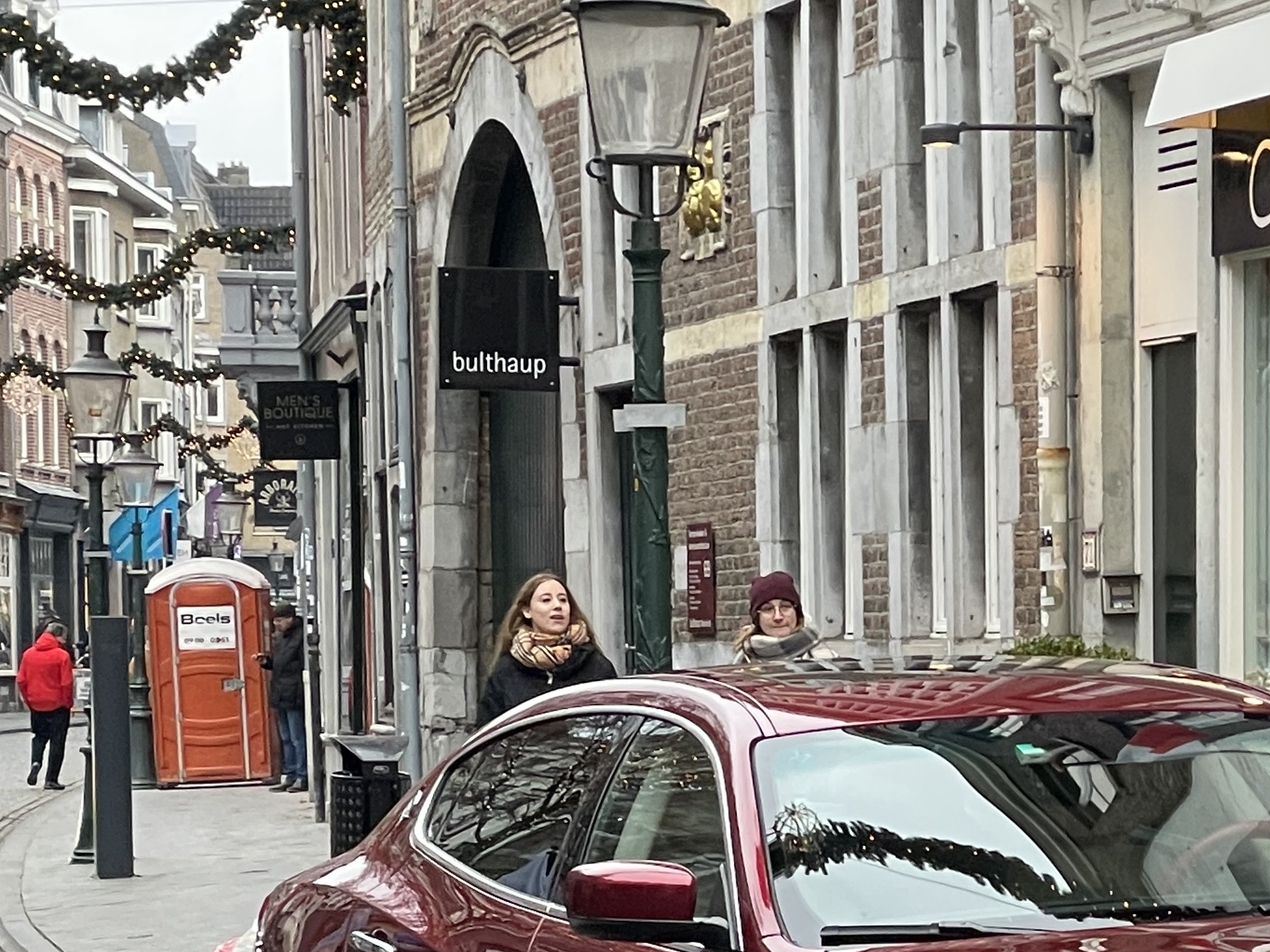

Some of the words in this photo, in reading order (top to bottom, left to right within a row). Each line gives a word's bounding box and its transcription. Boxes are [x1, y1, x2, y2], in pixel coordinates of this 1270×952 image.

[452, 350, 547, 380] bulthaup
[276, 394, 321, 407] MEN'S
[264, 406, 334, 420] BOUTIQUE
